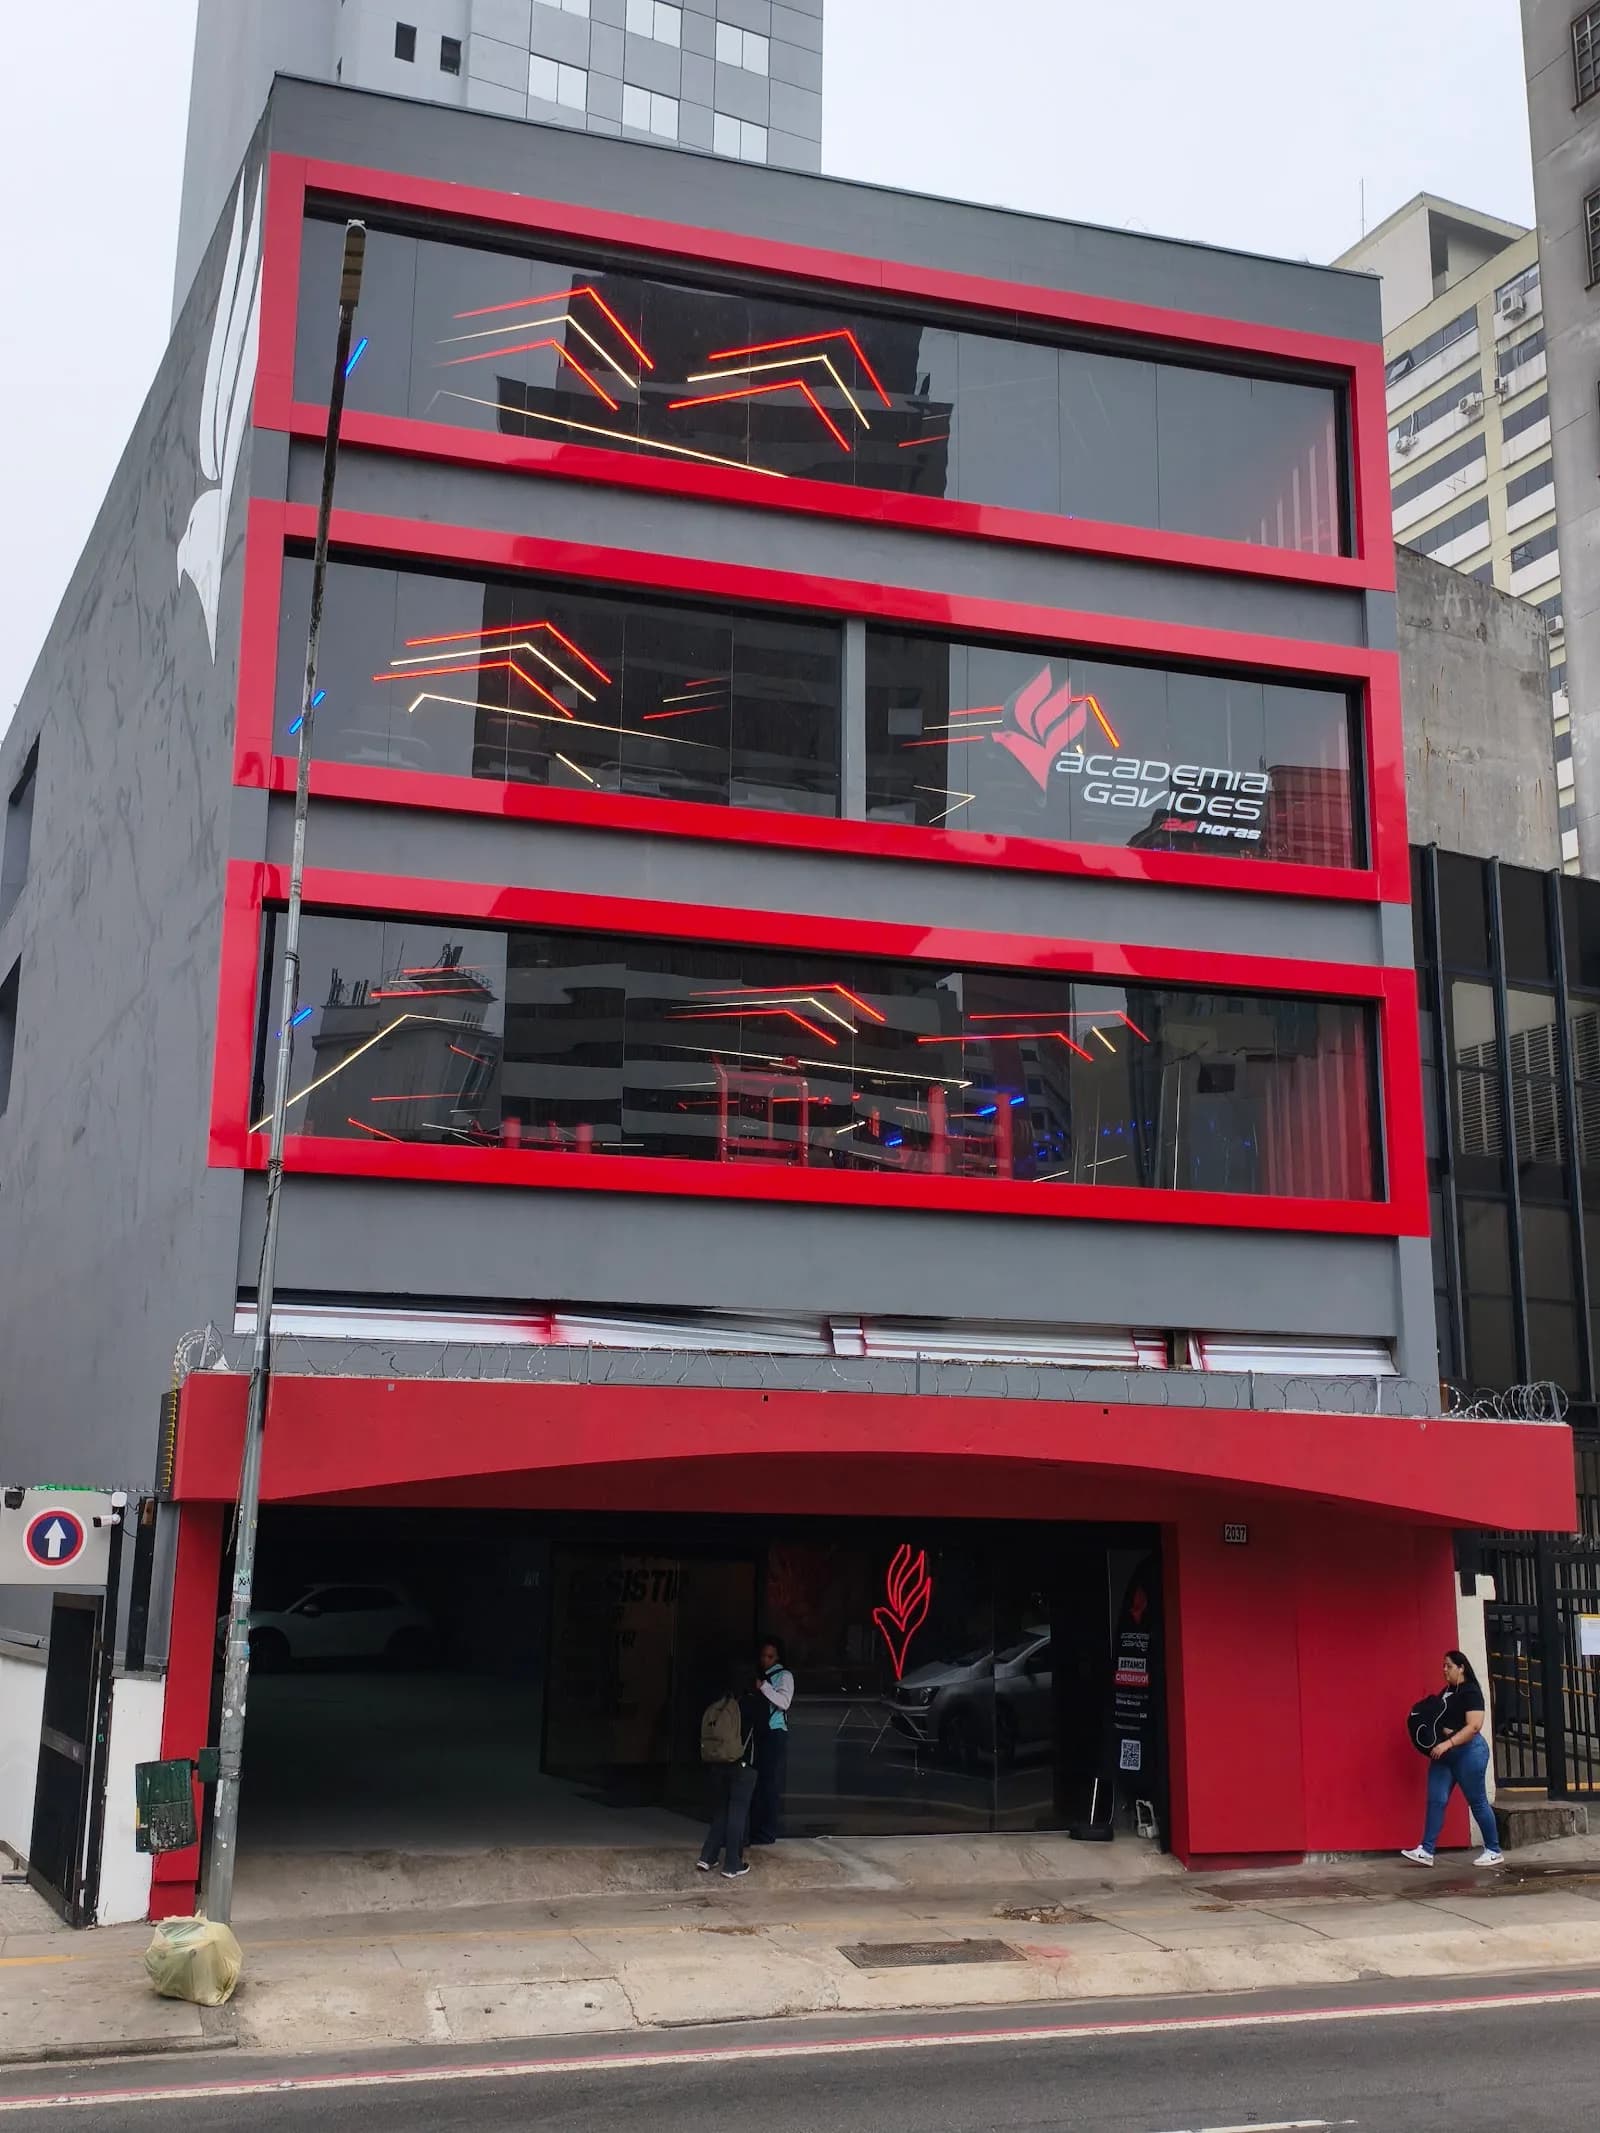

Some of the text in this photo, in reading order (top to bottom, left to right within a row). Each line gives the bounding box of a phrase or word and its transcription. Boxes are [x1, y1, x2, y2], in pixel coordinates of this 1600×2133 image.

[1160, 817, 1262, 840] 24 horas
[1226, 1525, 1246, 1540] 2037
